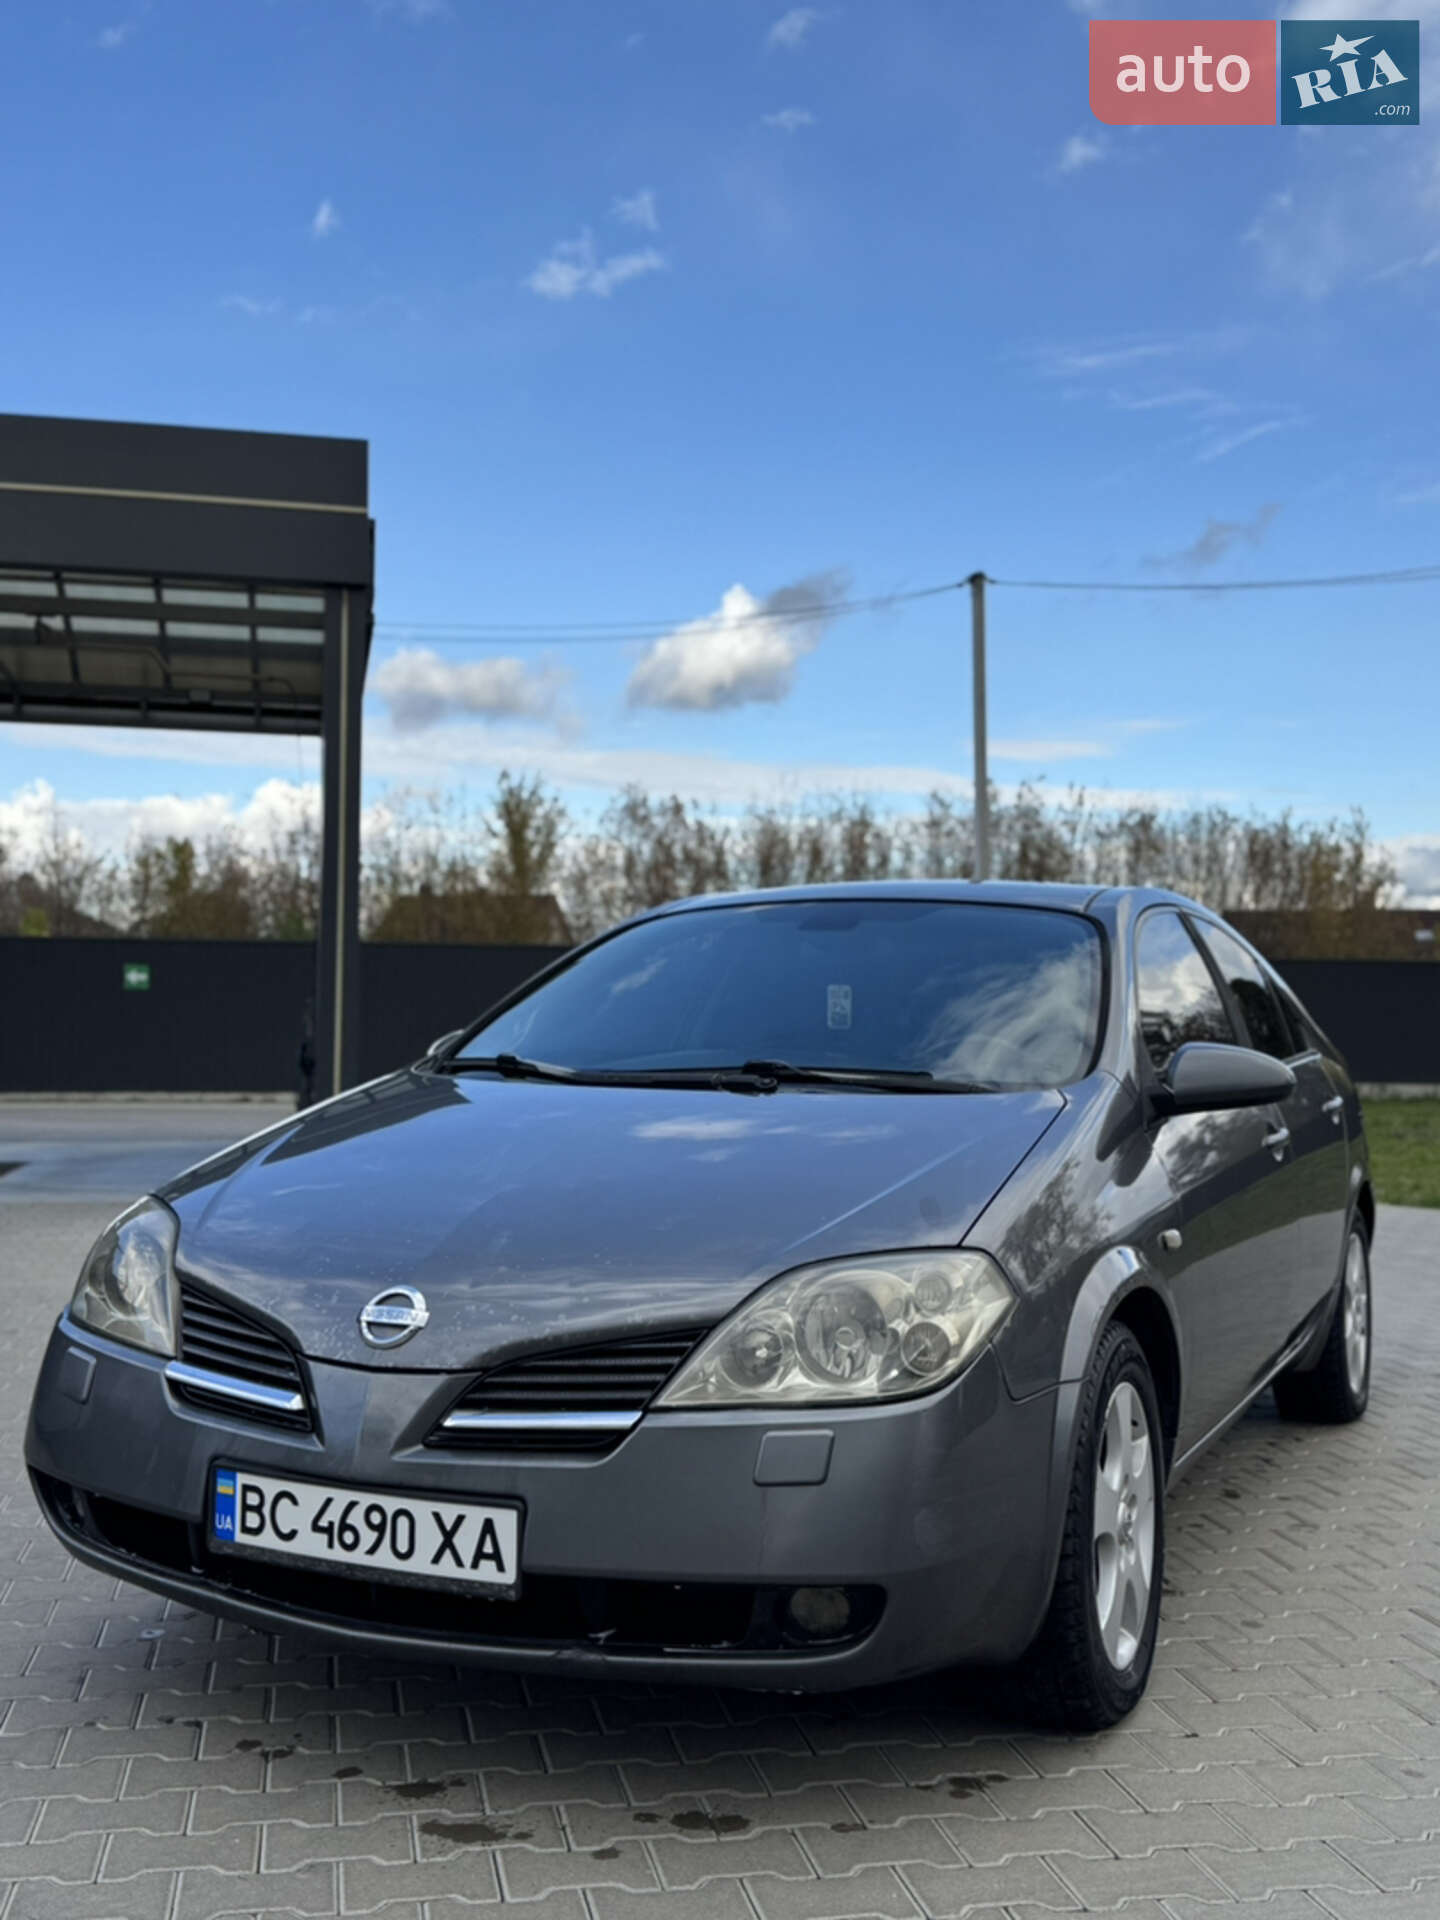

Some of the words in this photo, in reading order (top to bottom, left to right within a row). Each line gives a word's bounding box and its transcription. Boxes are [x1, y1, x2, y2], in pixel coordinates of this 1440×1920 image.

[215, 1513, 233, 1531] UA
[240, 1483, 299, 1542] BC
[311, 1497, 416, 1561] 4690
[430, 1511, 506, 1573] XA
